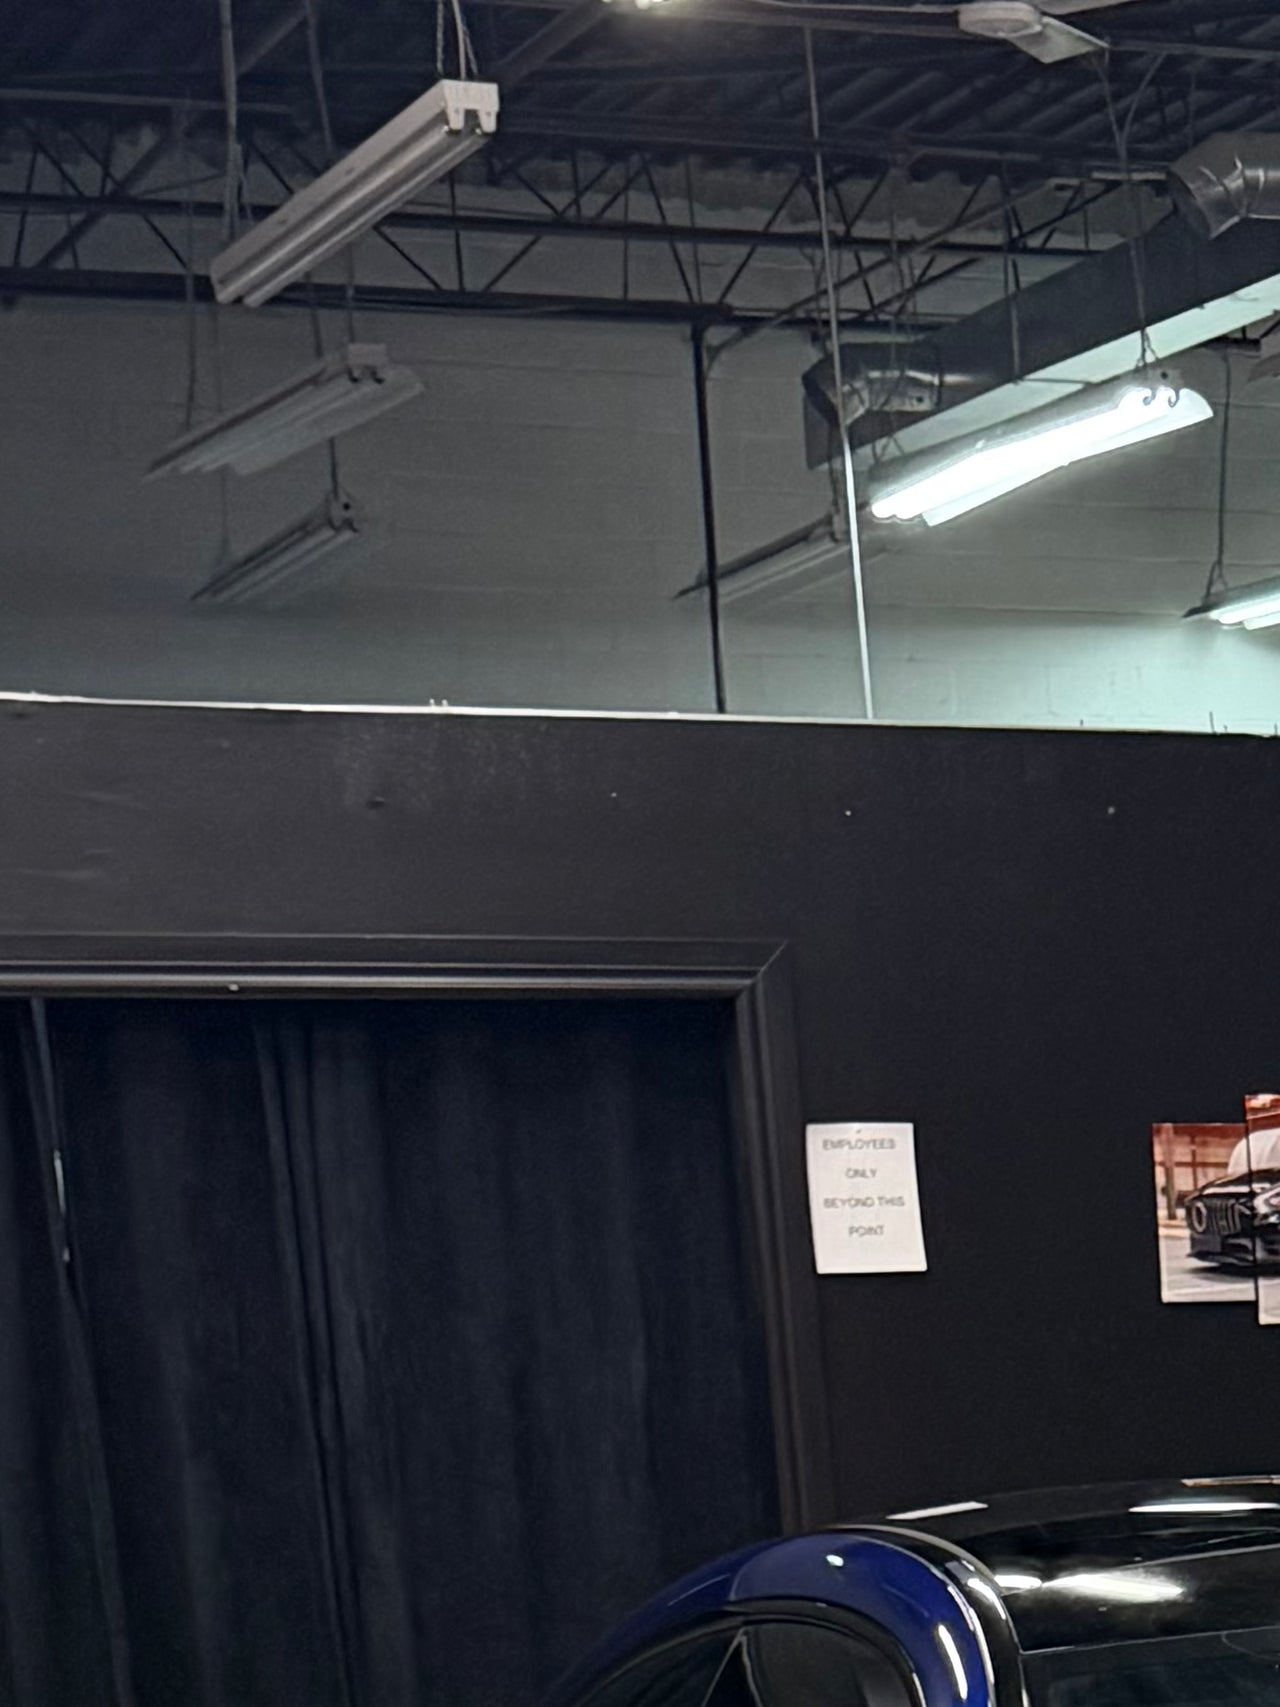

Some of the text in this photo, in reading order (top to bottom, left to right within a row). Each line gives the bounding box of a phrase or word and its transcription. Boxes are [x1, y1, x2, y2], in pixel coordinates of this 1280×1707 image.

[822, 1138, 896, 1151] EMPLOYEES
[845, 1168, 878, 1179] ONLY
[823, 1196, 906, 1209] BEYOND THIS
[848, 1225, 885, 1237] POINT
